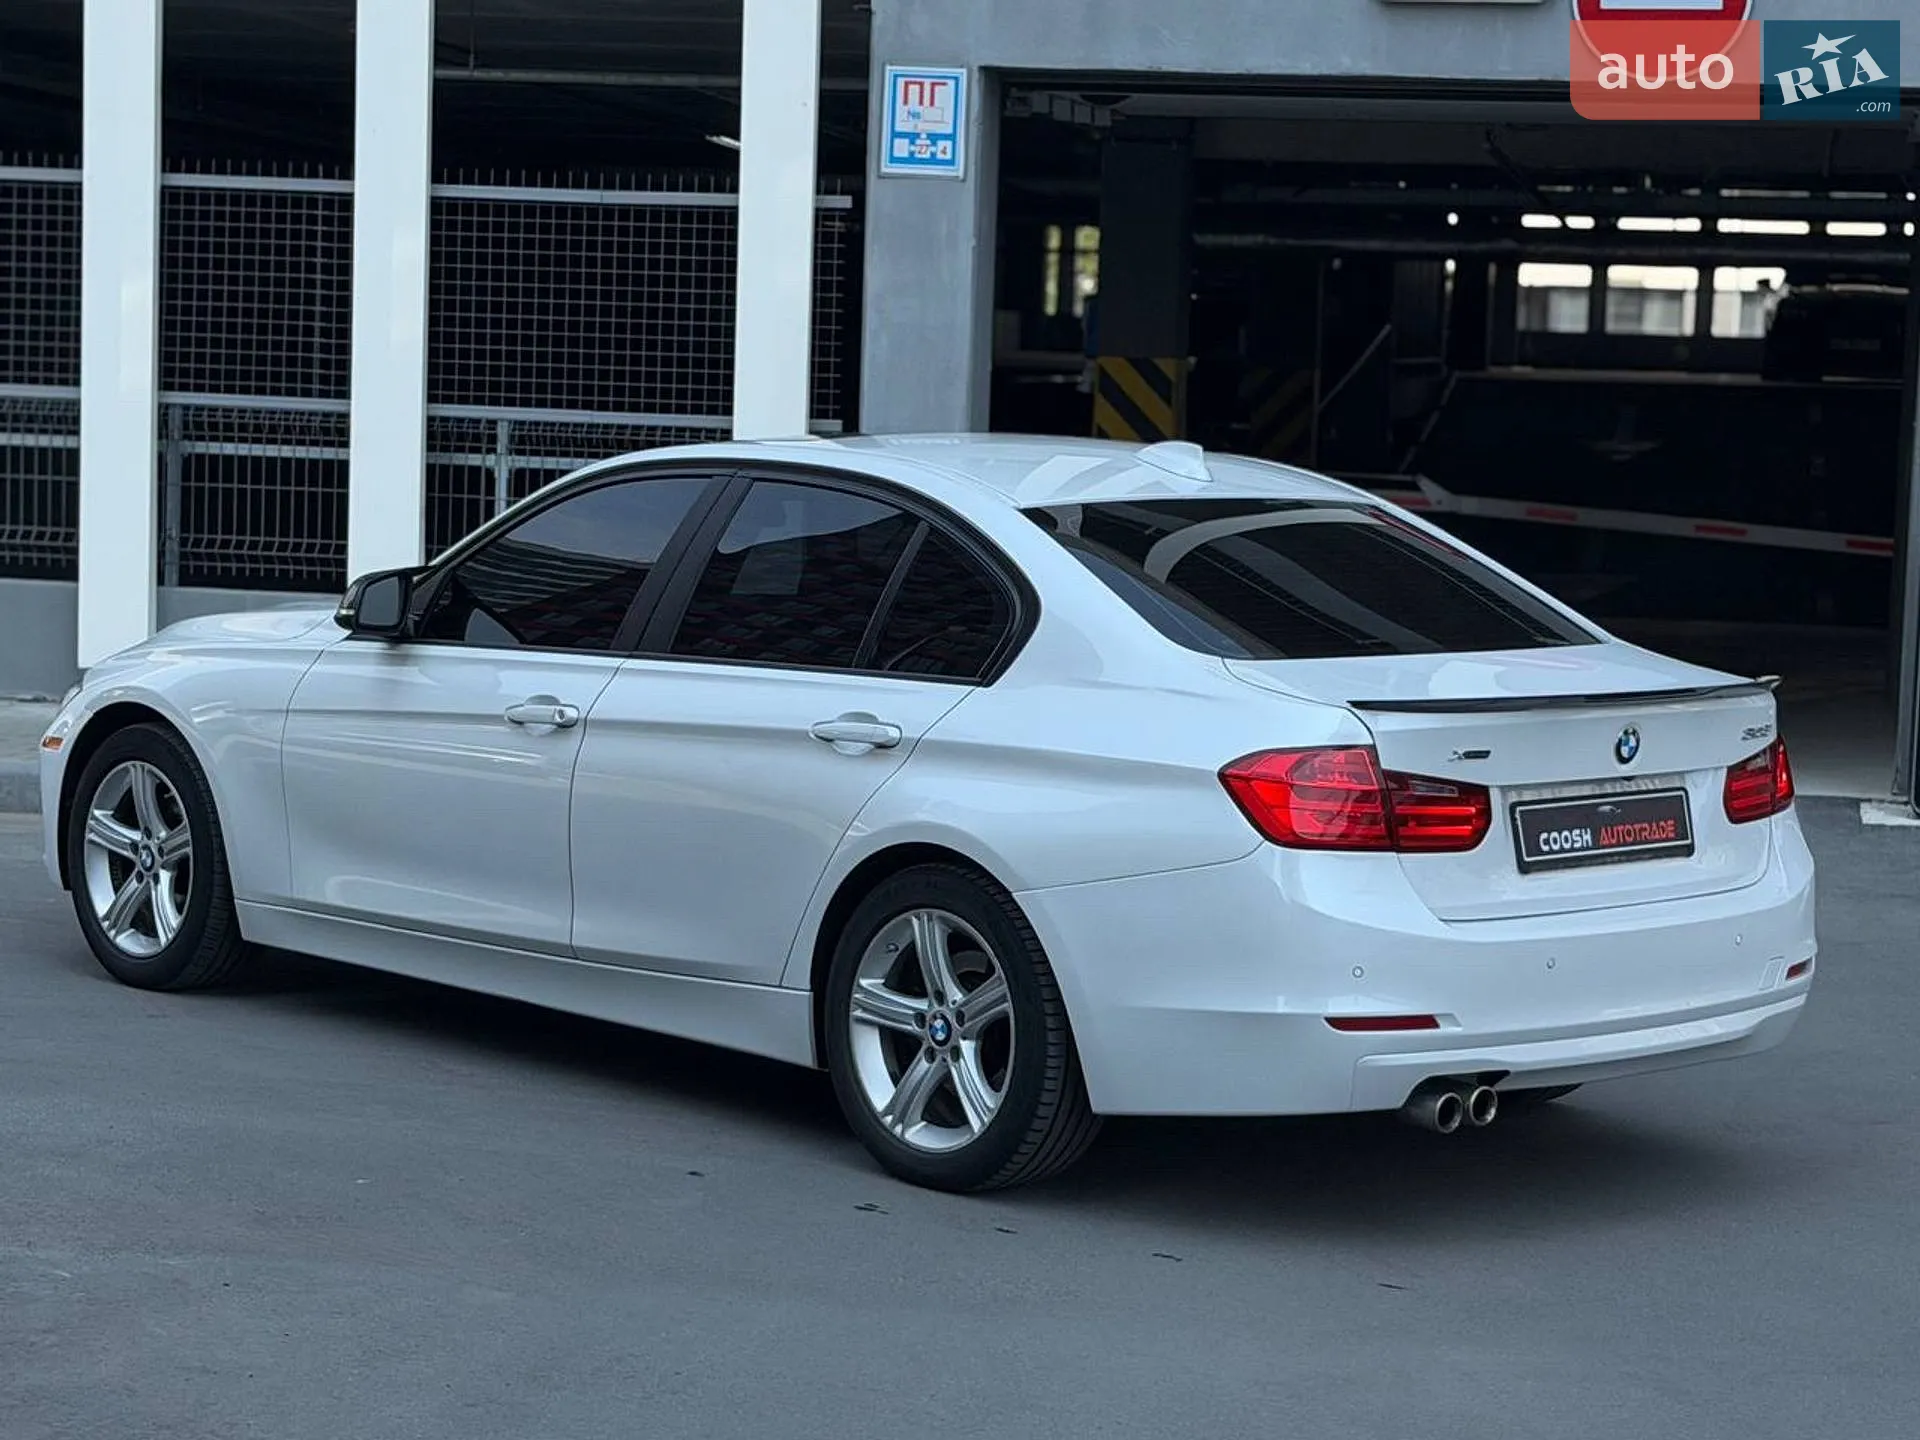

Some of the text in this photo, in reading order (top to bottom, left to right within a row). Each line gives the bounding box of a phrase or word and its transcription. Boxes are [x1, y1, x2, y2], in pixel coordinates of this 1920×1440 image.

[903, 80, 949, 107] ПГ
[1539, 819, 1677, 852] COOSH AUTOTRADE
